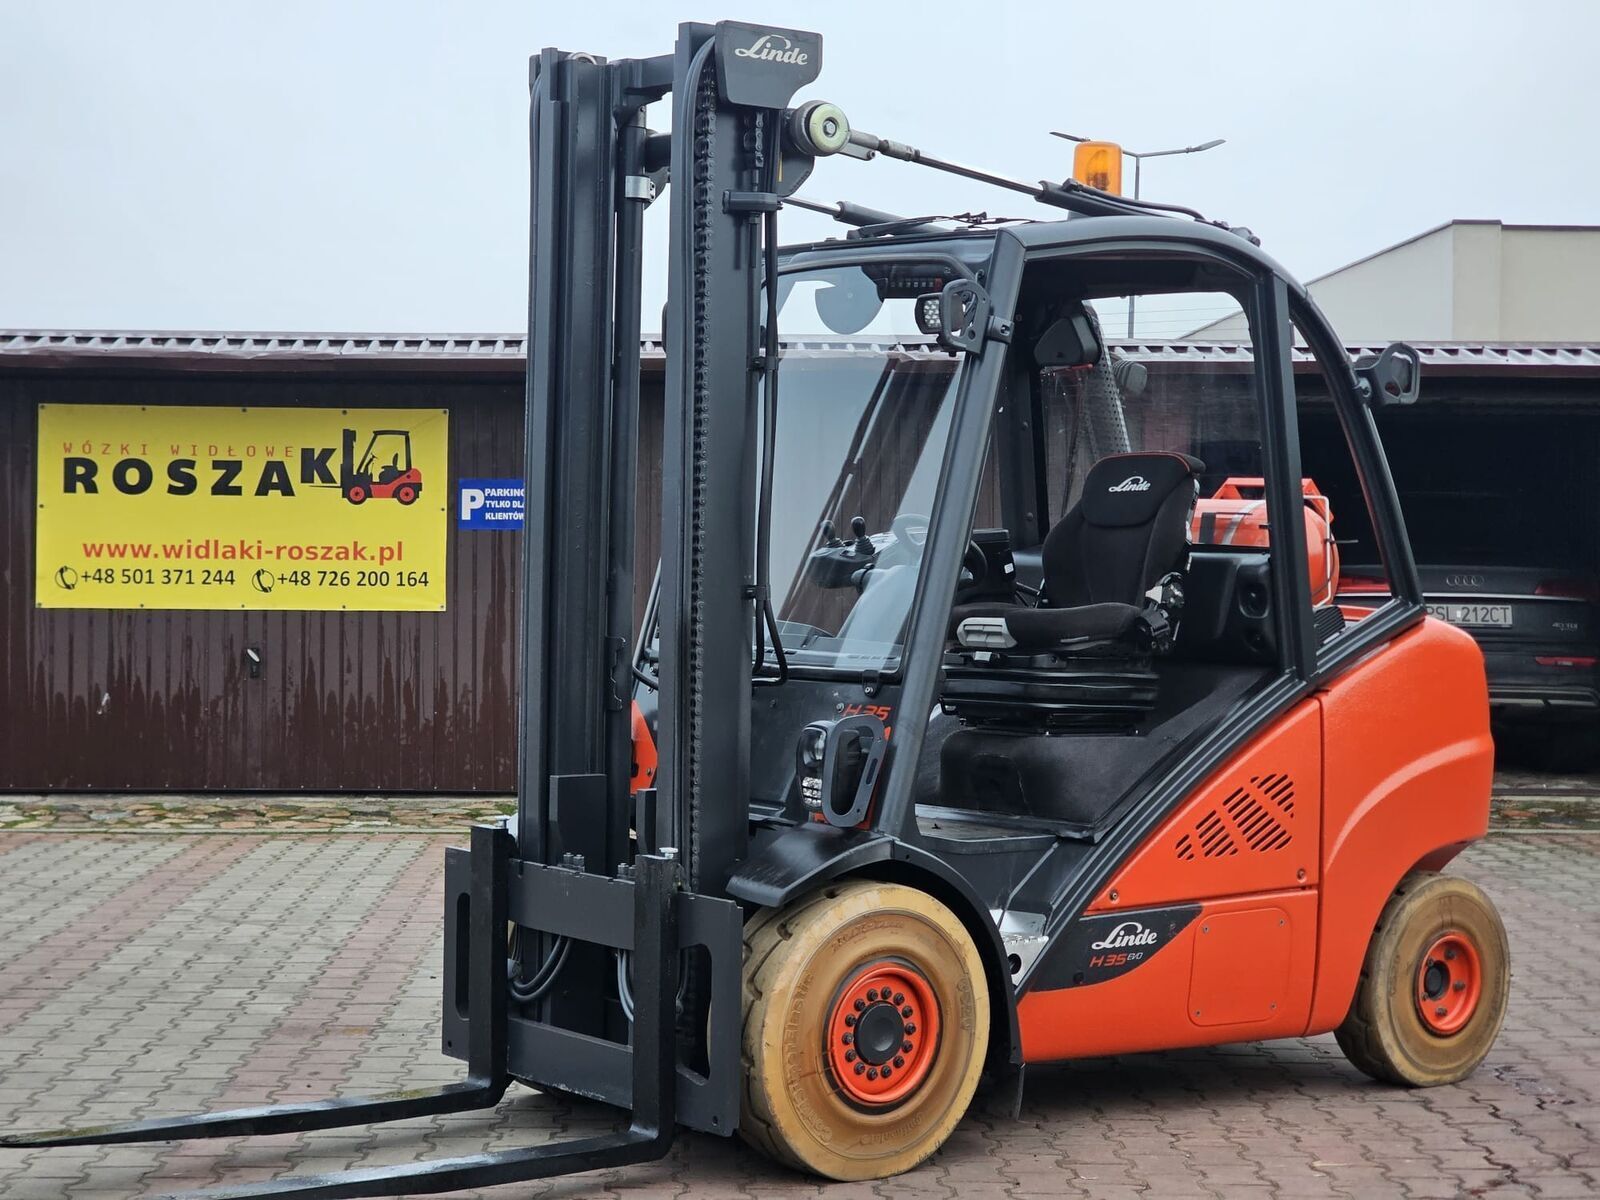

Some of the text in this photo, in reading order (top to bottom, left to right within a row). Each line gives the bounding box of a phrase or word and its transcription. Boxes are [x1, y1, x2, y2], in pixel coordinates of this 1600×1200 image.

[734, 34, 808, 65] Linde
[63, 440, 293, 457] WÓZKI WIDŁOWE
[63, 447, 337, 497] ROSZAK
[1108, 475, 1151, 492] Linde
[461, 488, 485, 520] P
[485, 500, 524, 508] TYLKO DL
[82, 539, 403, 566] www.widlaki-roszak.pl
[81, 568, 236, 585] +48 501 371 244
[277, 570, 429, 587] +48 726 200 164
[1461, 606, 1509, 623] 212CT
[1091, 921, 1158, 950] Linde
